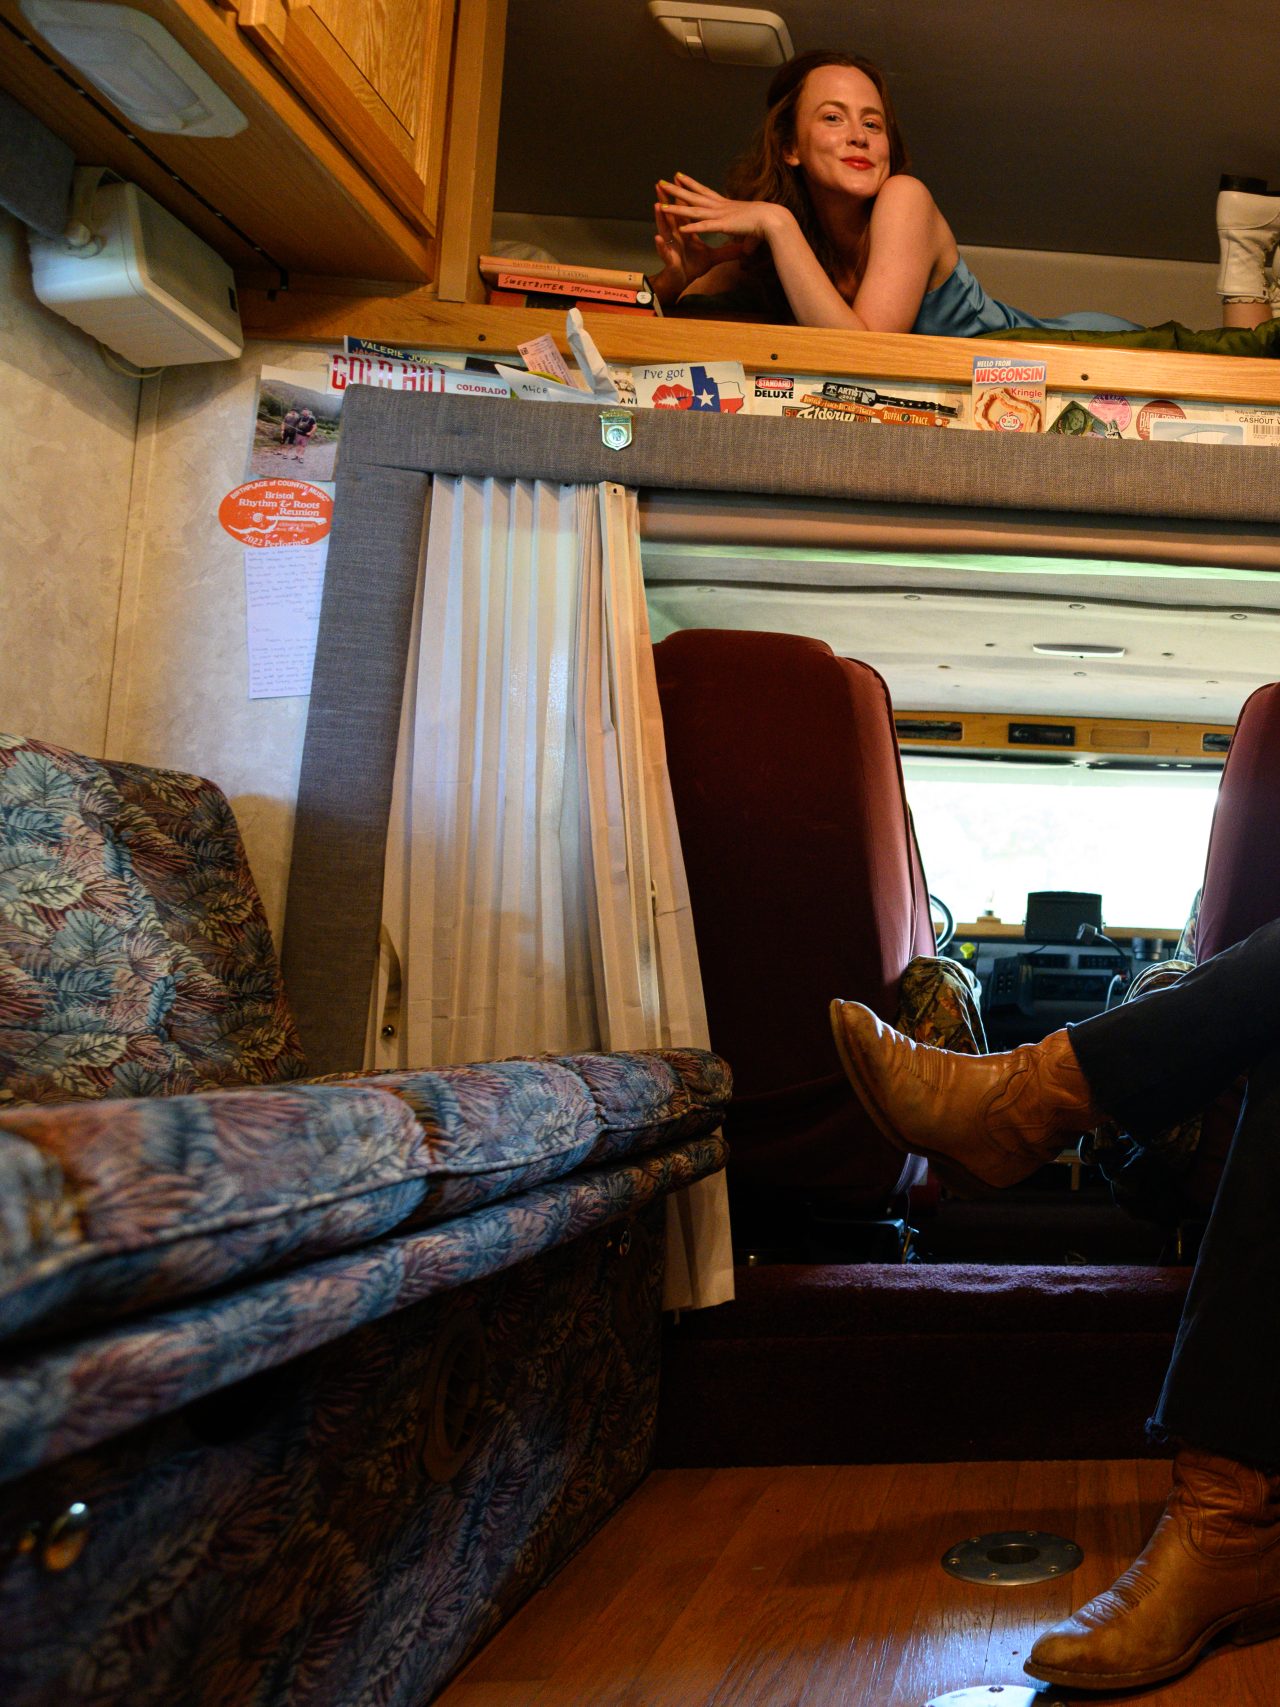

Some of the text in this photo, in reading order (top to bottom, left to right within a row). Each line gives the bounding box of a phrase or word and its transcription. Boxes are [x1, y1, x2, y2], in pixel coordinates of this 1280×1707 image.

[503, 275, 564, 291] SWEETBITTER
[360, 339, 404, 359] VALERIE
[976, 360, 994, 368] HELLO
[643, 367, 684, 381] I've got
[974, 366, 1045, 384] WISCONSIN
[456, 383, 508, 396] COLORADO
[757, 378, 792, 389] STANDARD
[754, 389, 794, 400] DELUXE
[838, 384, 863, 399] ARTIST
[1011, 386, 1043, 398] Kringle
[882, 411, 912, 423] BUFFAL
[910, 413, 930, 426] TRACE
[1239, 416, 1274, 426] CASHOUT
[277, 479, 308, 491] COUNTRY
[265, 490, 294, 500] Bristol
[238, 498, 277, 508] Rhythm
[293, 500, 320, 509] Roots
[279, 507, 320, 517] Reunion
[242, 534, 310, 548] 2022 Performer
